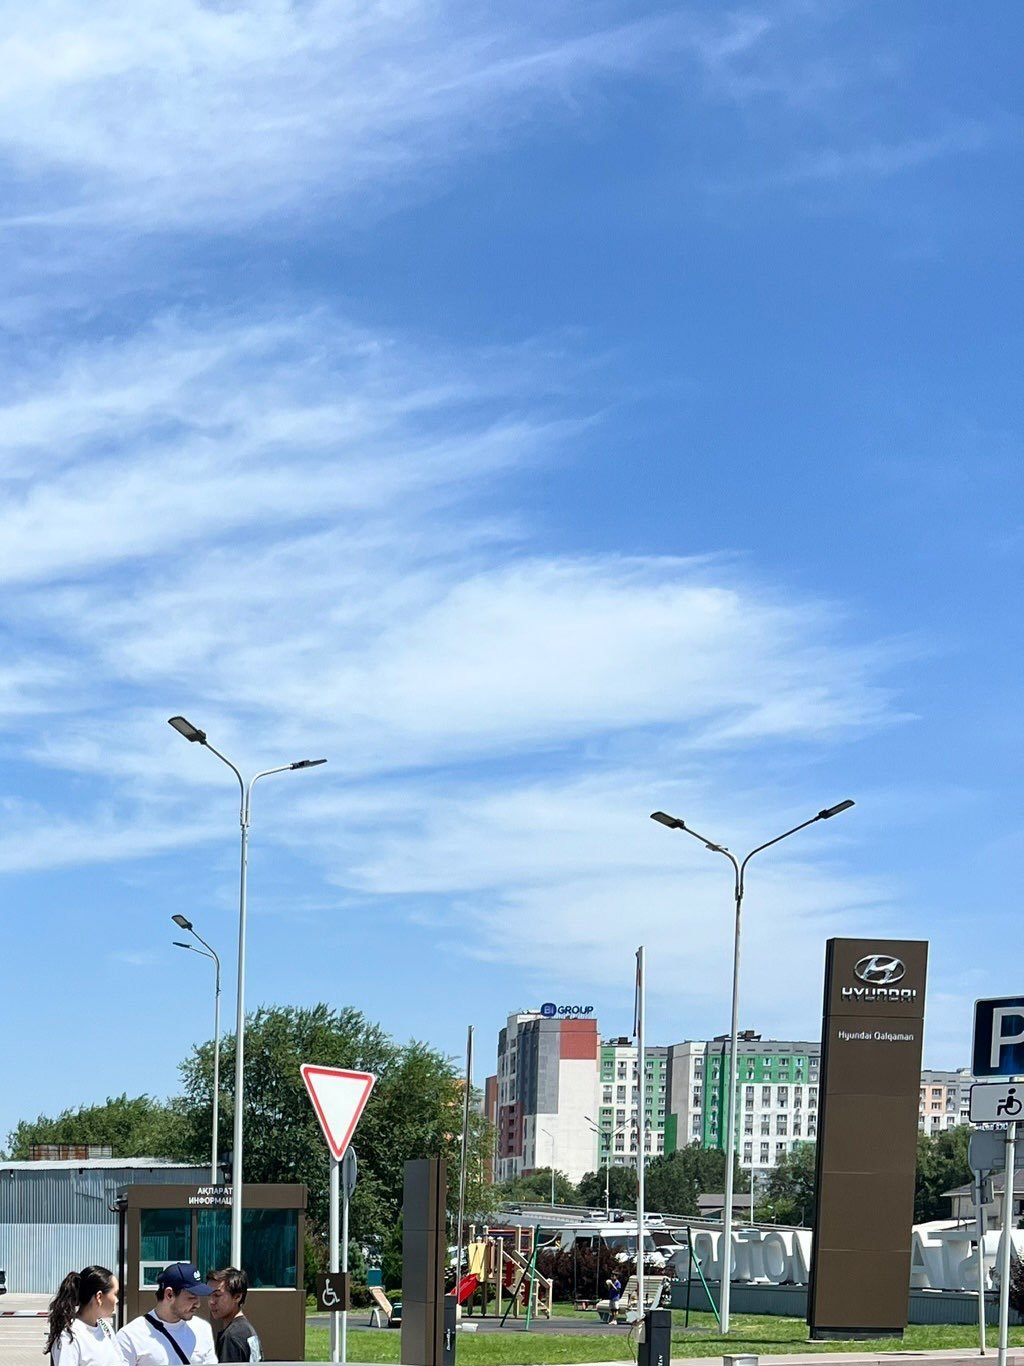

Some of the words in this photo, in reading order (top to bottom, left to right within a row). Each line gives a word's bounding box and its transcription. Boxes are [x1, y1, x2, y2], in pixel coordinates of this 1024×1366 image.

[841, 987, 916, 1002] HYUNDAI
[558, 1005, 594, 1015] GROUP
[838, 1031, 872, 1041] Hyundai
[874, 1031, 914, 1042] Qalqaman
[990, 1006, 1024, 1068] P
[188, 1197, 233, 1205] ИНФОРМАЦ
